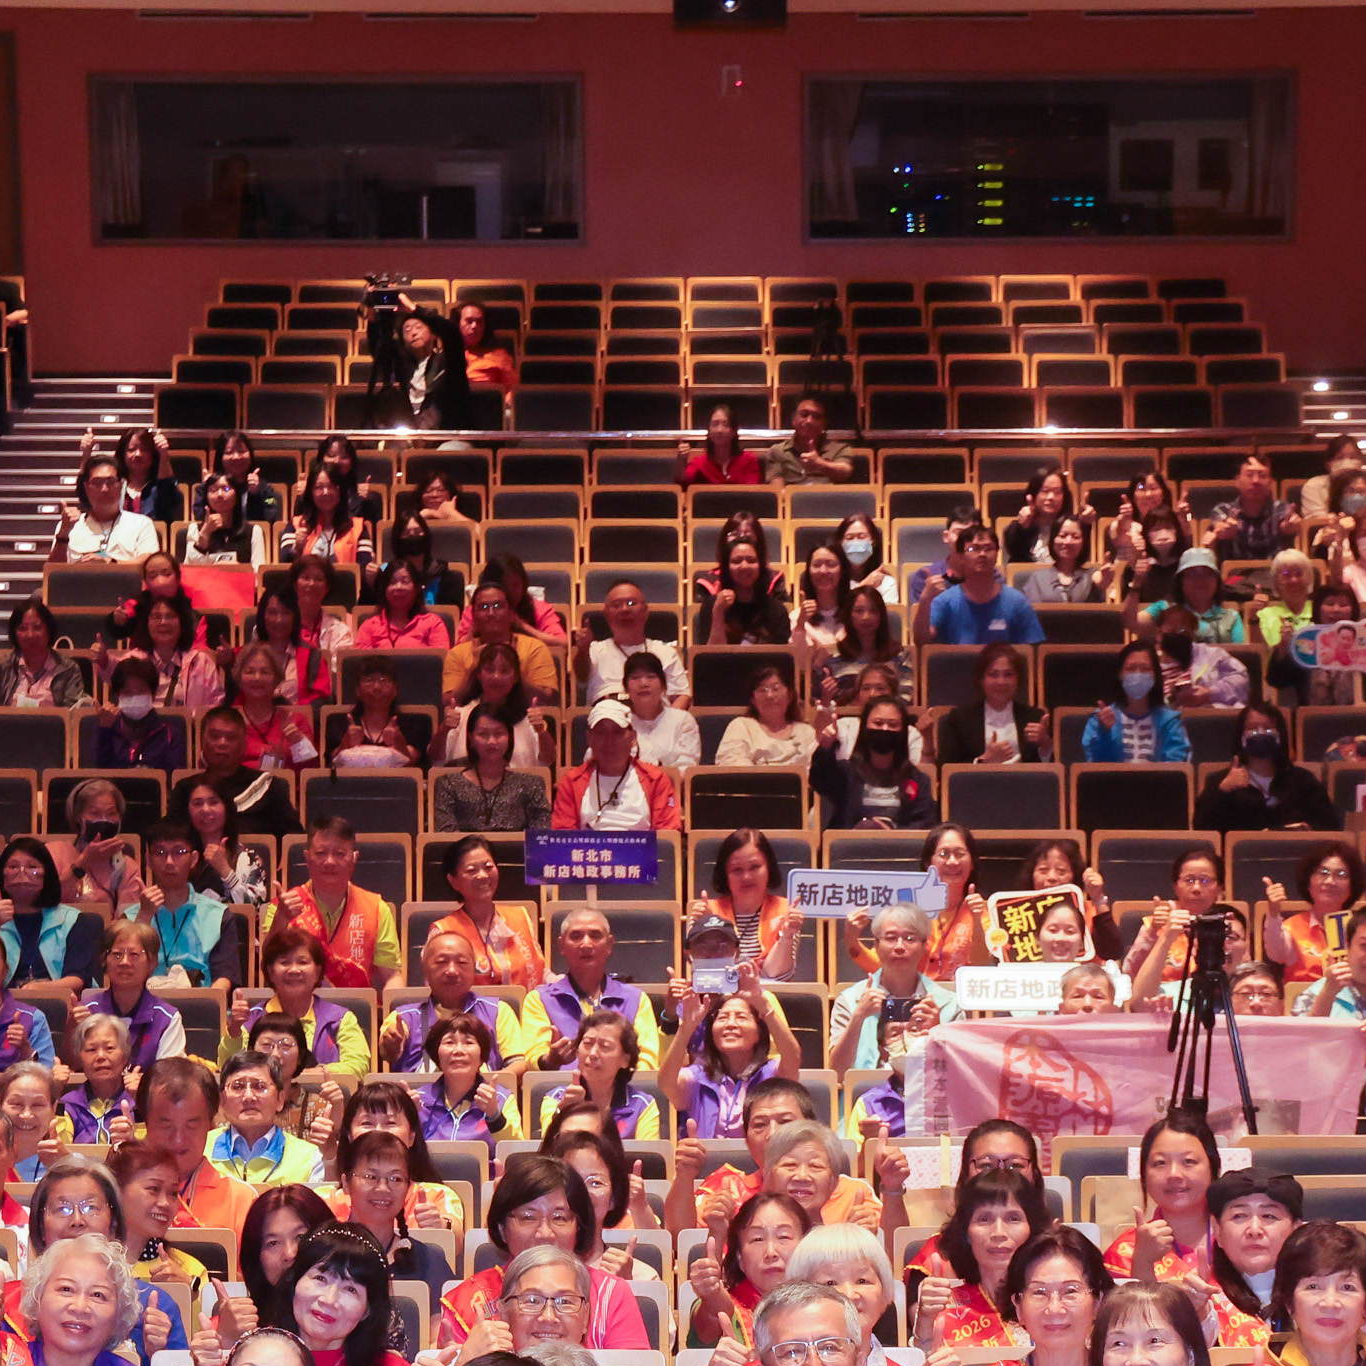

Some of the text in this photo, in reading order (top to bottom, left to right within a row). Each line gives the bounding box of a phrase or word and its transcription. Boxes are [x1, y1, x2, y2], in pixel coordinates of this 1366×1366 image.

[571, 849, 613, 862] 新北市
[543, 865, 641, 879] 新店地政事務所
[796, 882, 894, 907] 新店地政
[348, 913, 365, 965] 新店地
[933, 1059, 950, 1135] 林本源園
[952, 1315, 991, 1342] 2026
